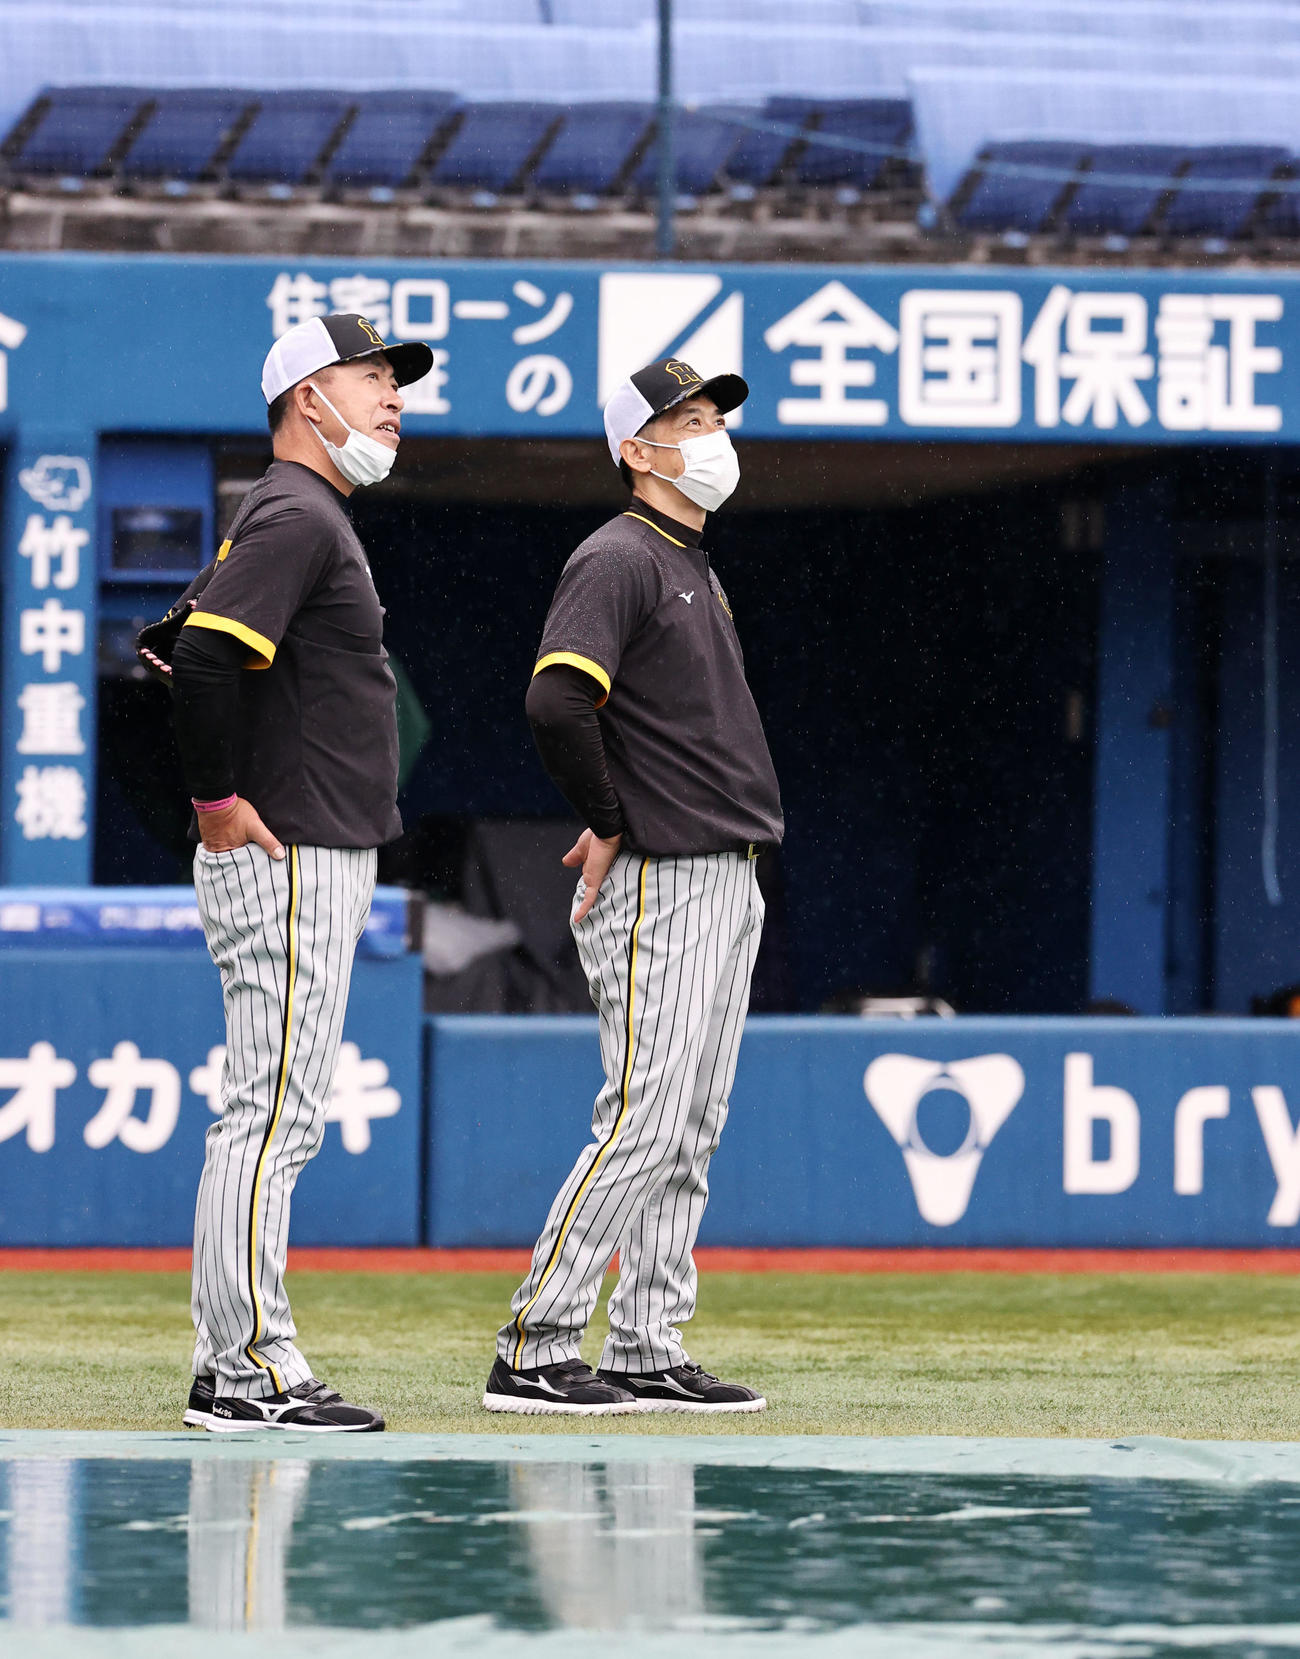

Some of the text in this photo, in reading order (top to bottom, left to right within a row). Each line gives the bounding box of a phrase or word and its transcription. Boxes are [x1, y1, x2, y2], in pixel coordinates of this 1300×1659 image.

[763, 280, 1284, 432] 全国保証
[0, 1041, 401, 1153] オカキ
